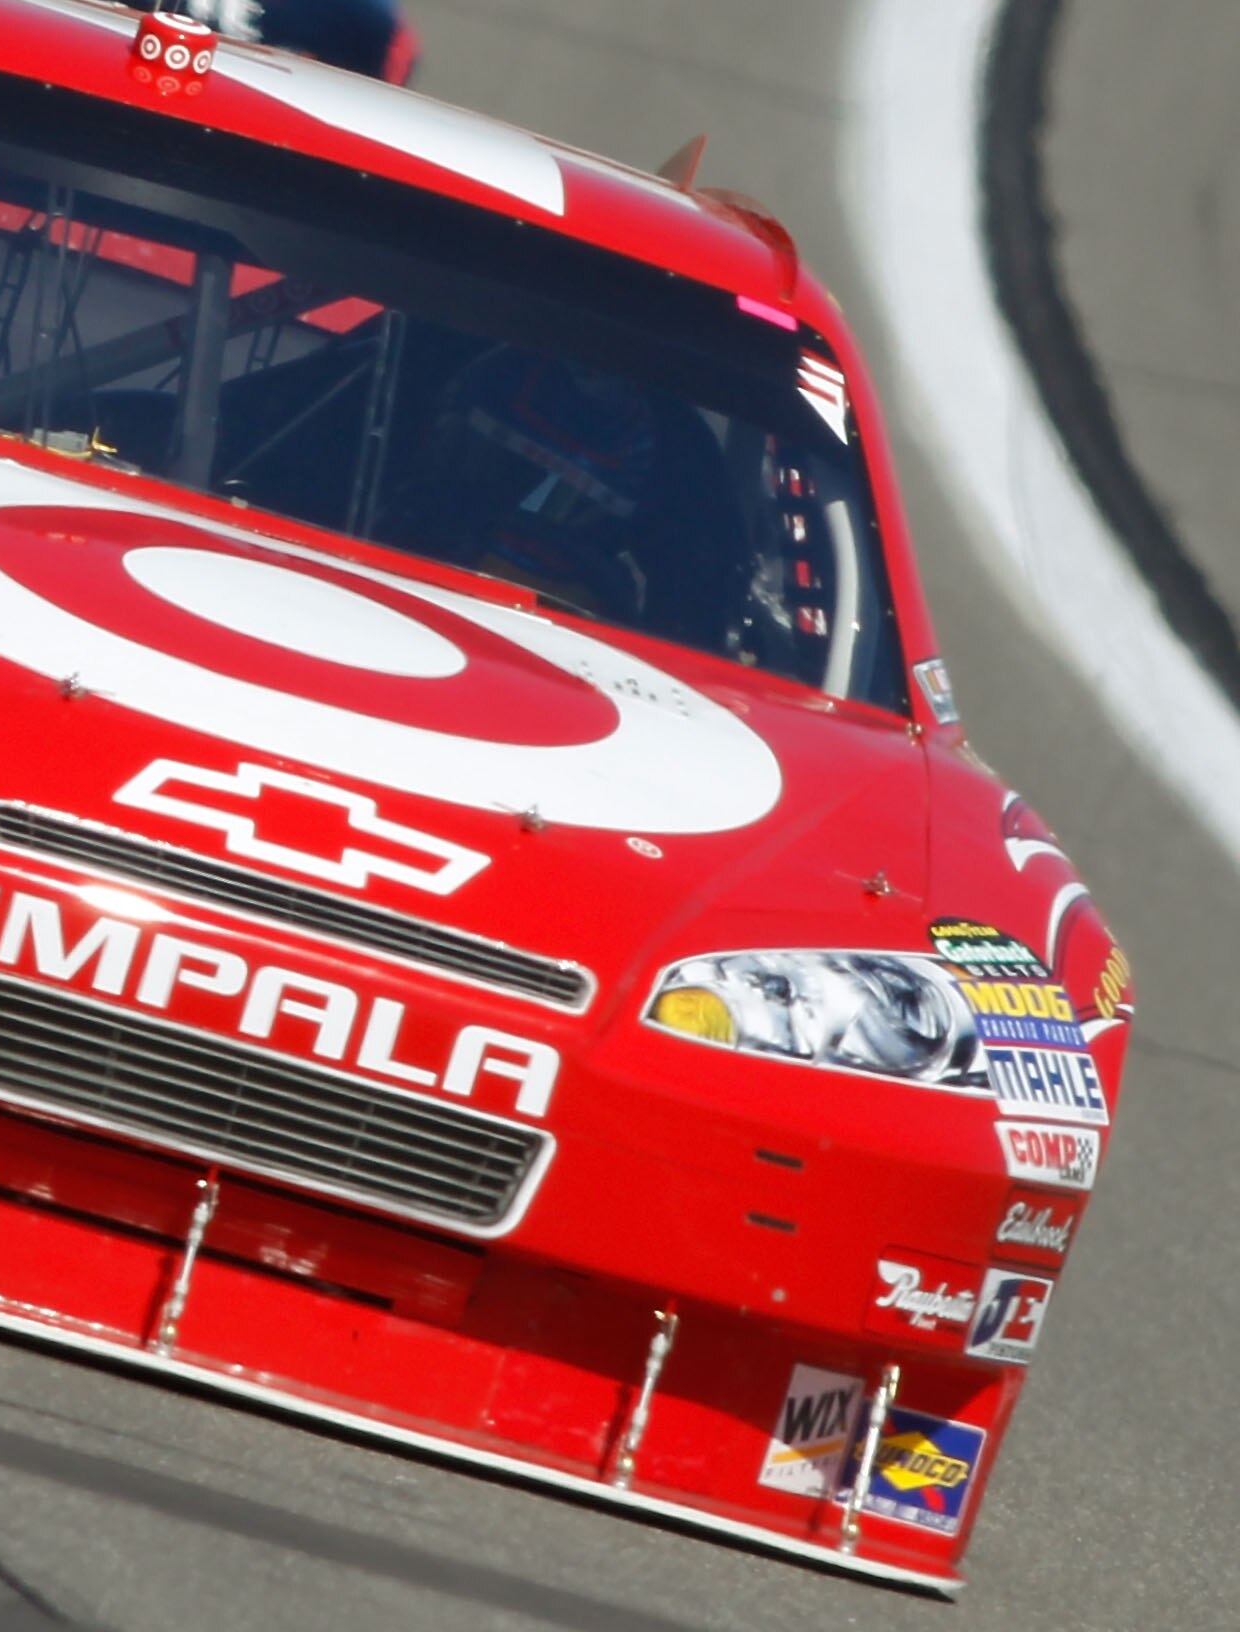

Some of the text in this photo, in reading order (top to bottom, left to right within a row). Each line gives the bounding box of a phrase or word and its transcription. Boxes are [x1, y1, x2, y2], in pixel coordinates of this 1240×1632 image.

[966, 963, 1049, 978] BELTS
[961, 981, 1074, 1023] MOOG
[987, 1050, 1104, 1109] MAHLE
[1008, 1129, 1078, 1168] COMP
[970, 1277, 1047, 1348] JE
[783, 1387, 855, 1444] WIX
[860, 1440, 960, 1483] UNOCO
